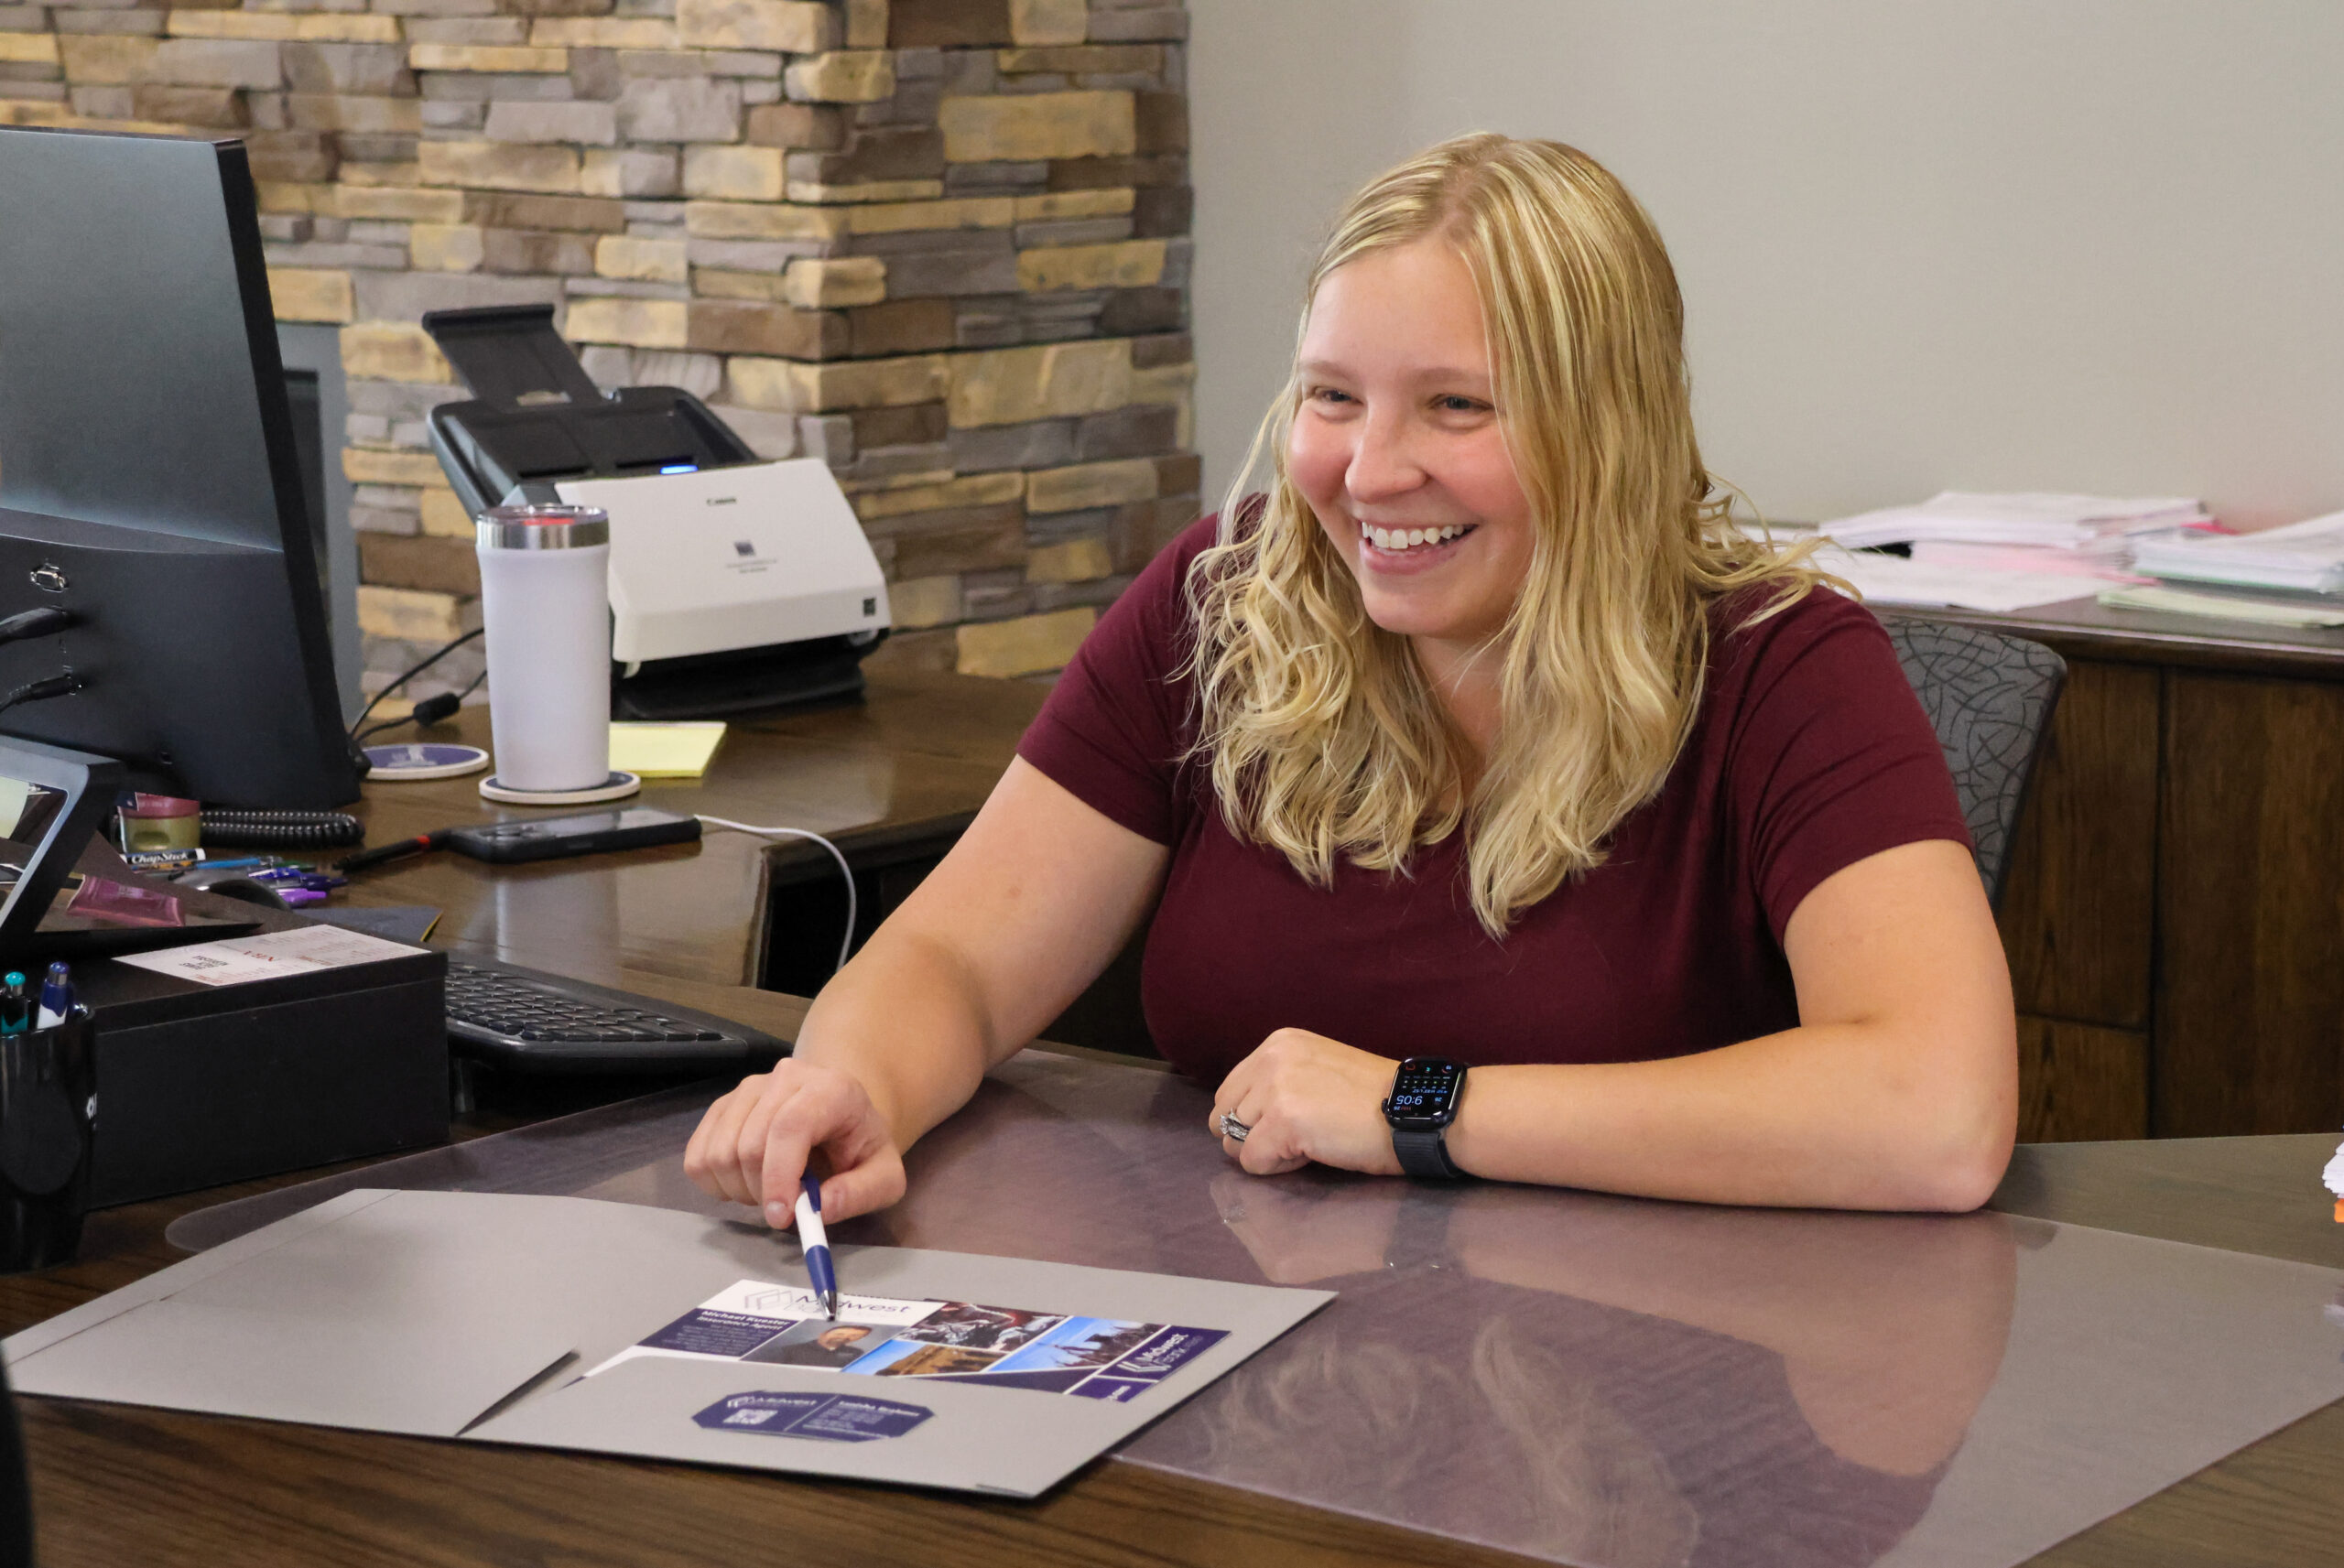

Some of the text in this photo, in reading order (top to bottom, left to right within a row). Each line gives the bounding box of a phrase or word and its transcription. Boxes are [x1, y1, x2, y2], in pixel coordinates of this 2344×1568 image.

[131, 852, 188, 864] ChapStick
[1396, 1095, 1423, 1106] 9:05
[701, 1310, 746, 1322] Michael
[697, 1315, 784, 1331] Insurance Agent
